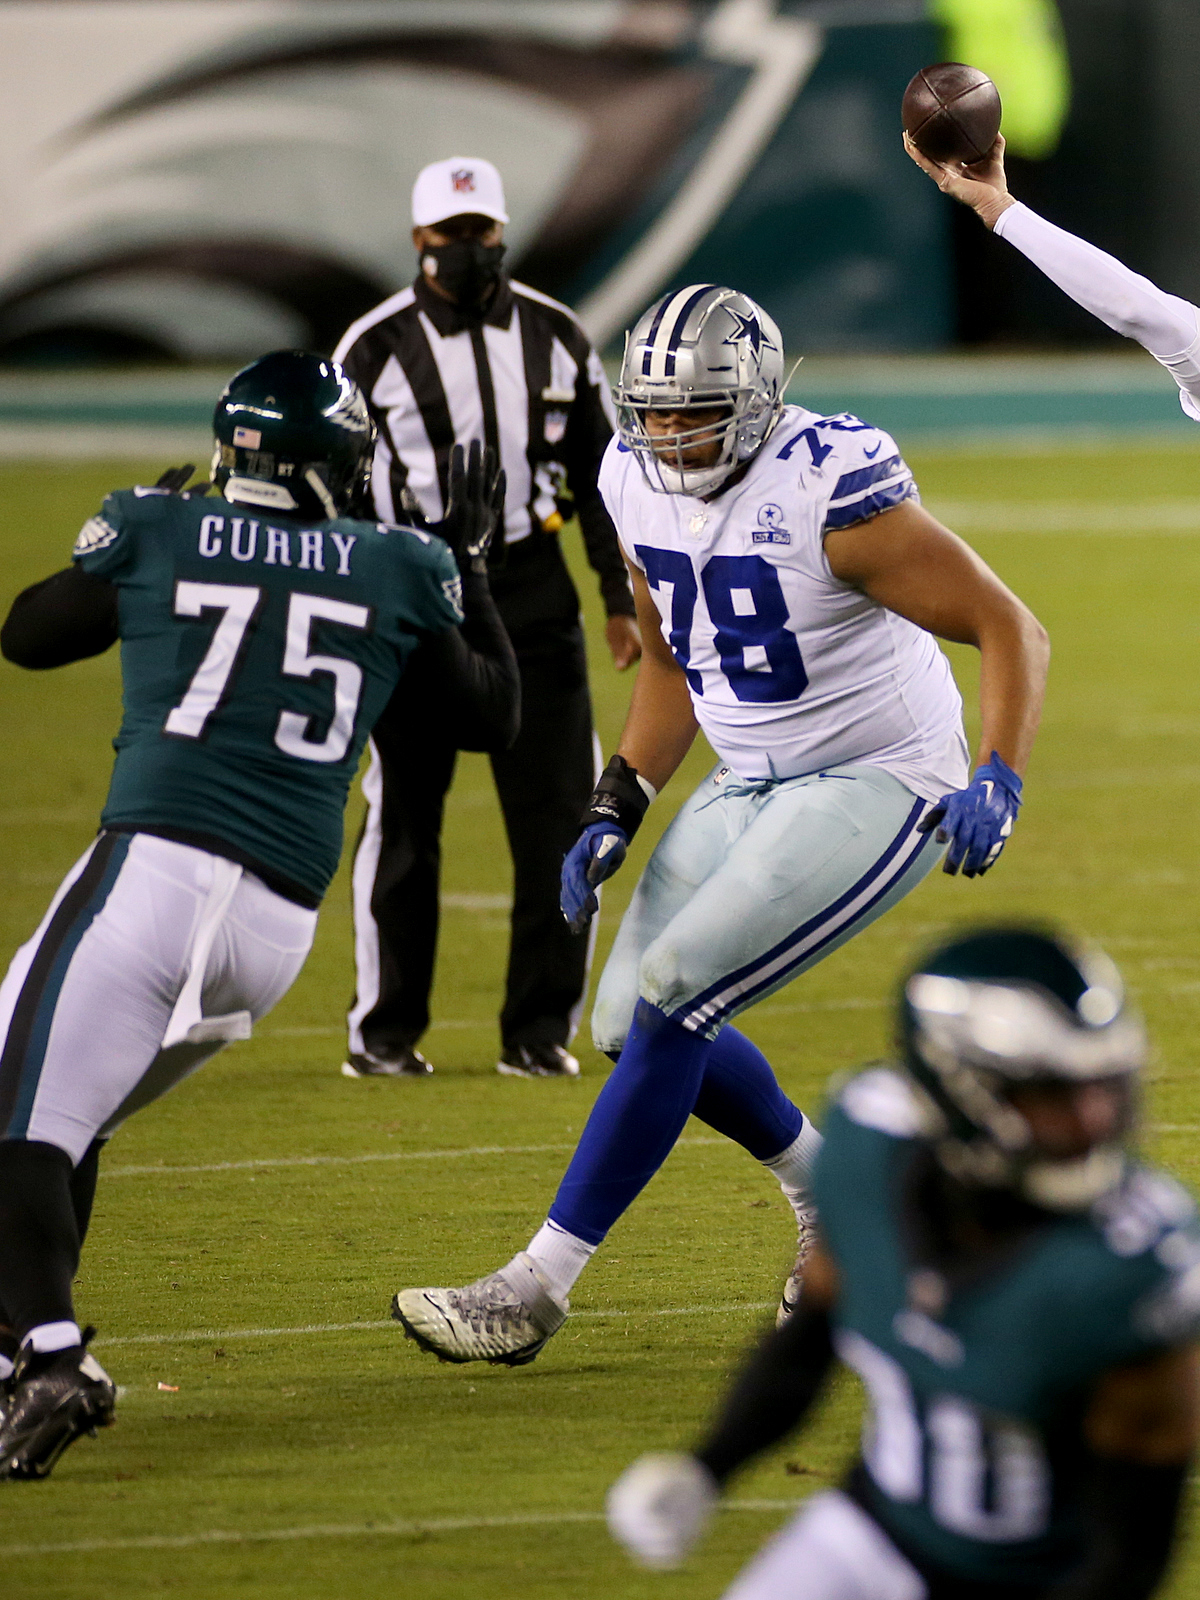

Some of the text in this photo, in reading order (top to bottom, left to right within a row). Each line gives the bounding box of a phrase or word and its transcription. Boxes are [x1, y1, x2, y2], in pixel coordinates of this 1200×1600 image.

[198, 514, 357, 576] CURRY
[634, 544, 809, 703] 78
[162, 579, 371, 763] 75
